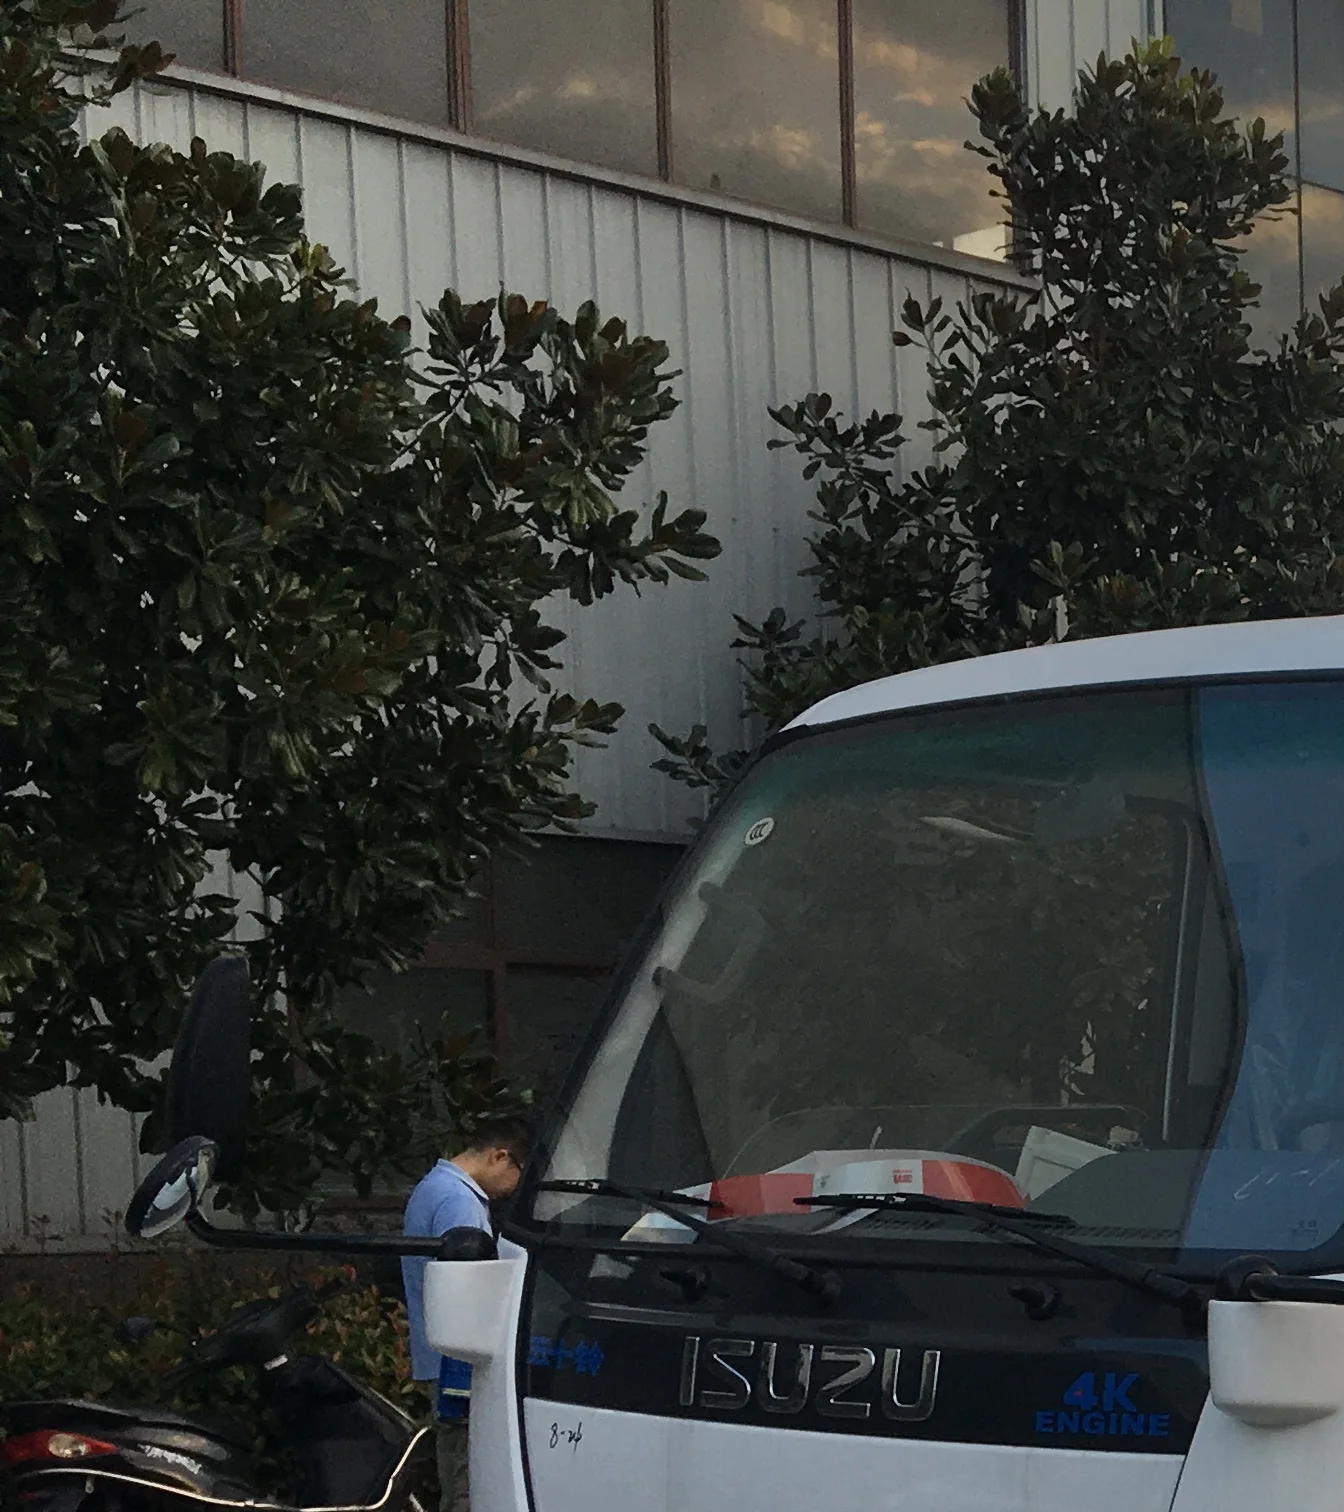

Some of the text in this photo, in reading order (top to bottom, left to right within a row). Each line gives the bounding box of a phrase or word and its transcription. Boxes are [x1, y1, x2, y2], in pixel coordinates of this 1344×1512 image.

[679, 1335, 941, 1421] ISUZU
[1063, 1371, 1139, 1412] 4K
[1035, 1410, 1169, 1437] ENGINE
